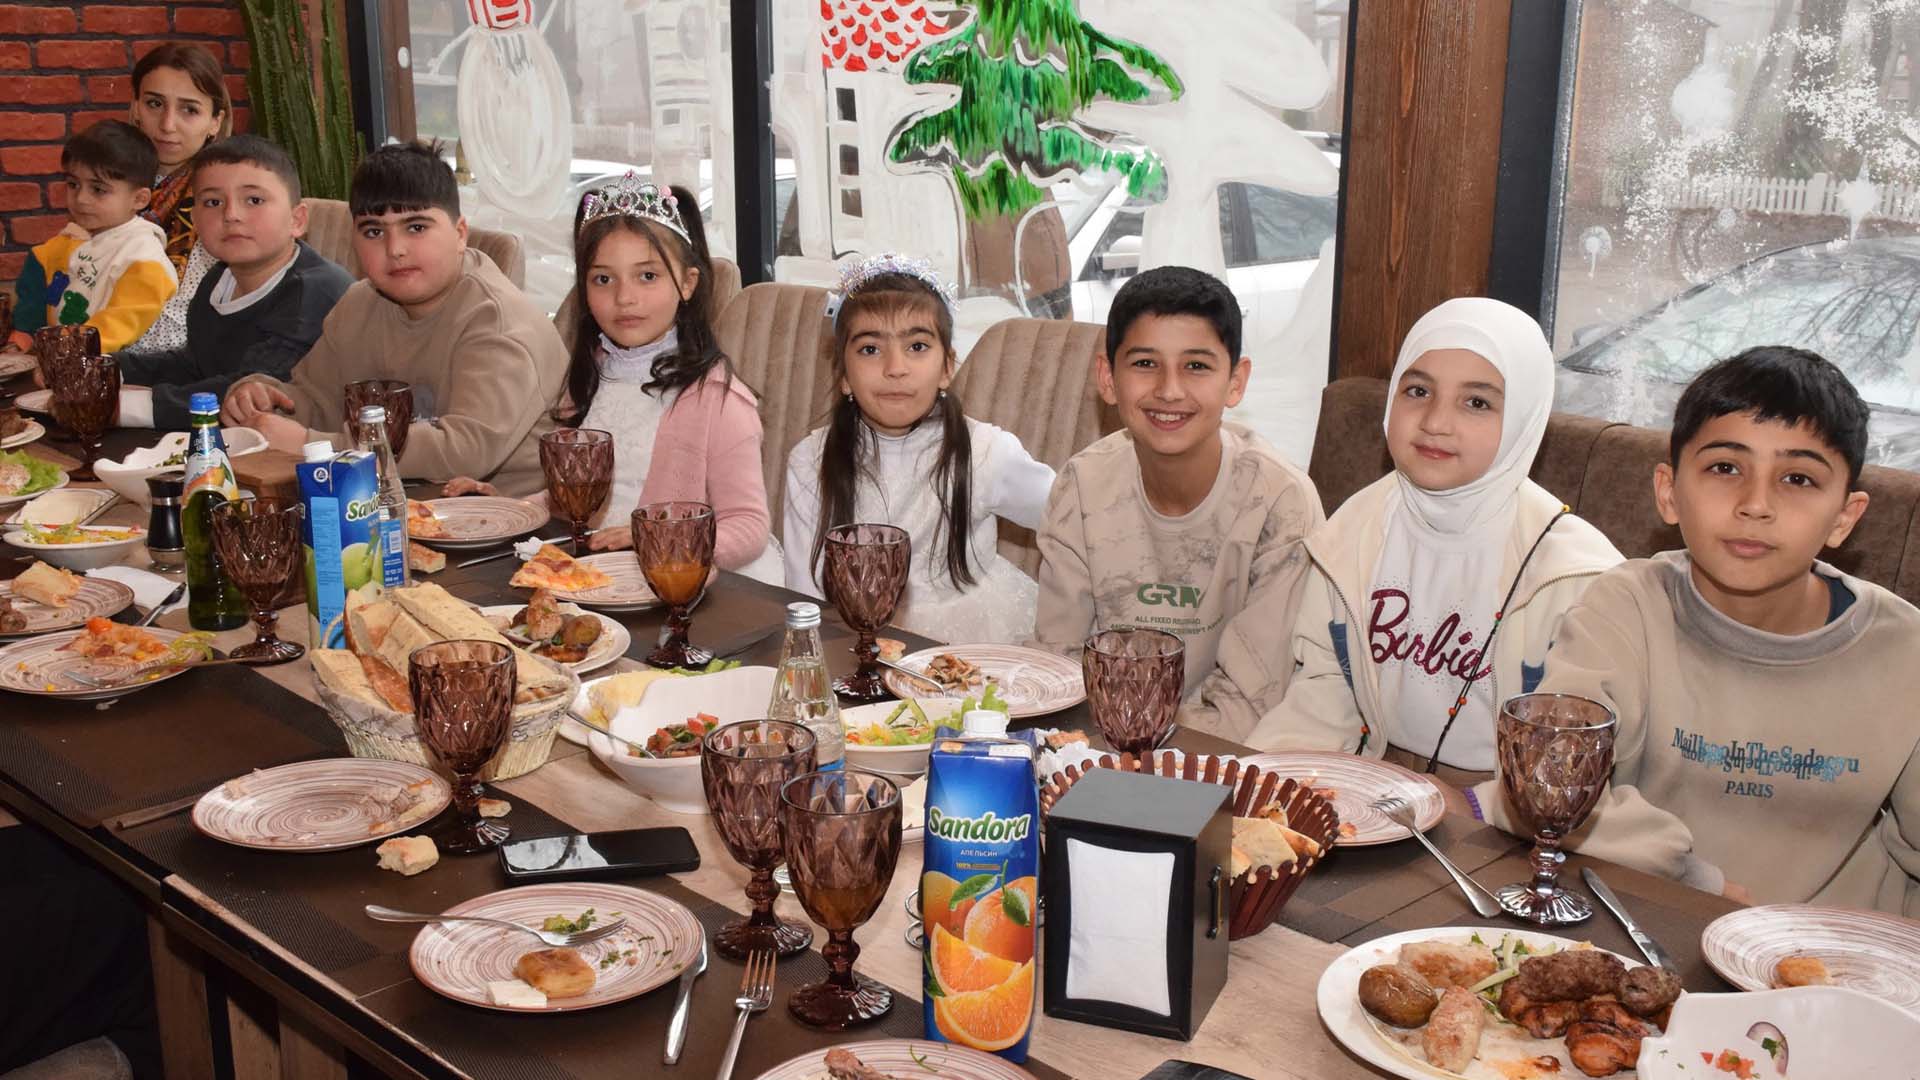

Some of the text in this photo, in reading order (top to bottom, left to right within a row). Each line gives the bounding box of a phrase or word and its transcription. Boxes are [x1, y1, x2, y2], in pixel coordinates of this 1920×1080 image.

[1368, 588, 1492, 681] Barbie
[1725, 780, 1774, 799] PARIS
[928, 805, 1032, 844] Sandora
[960, 848, 998, 857] АПЕЛЬСИН
